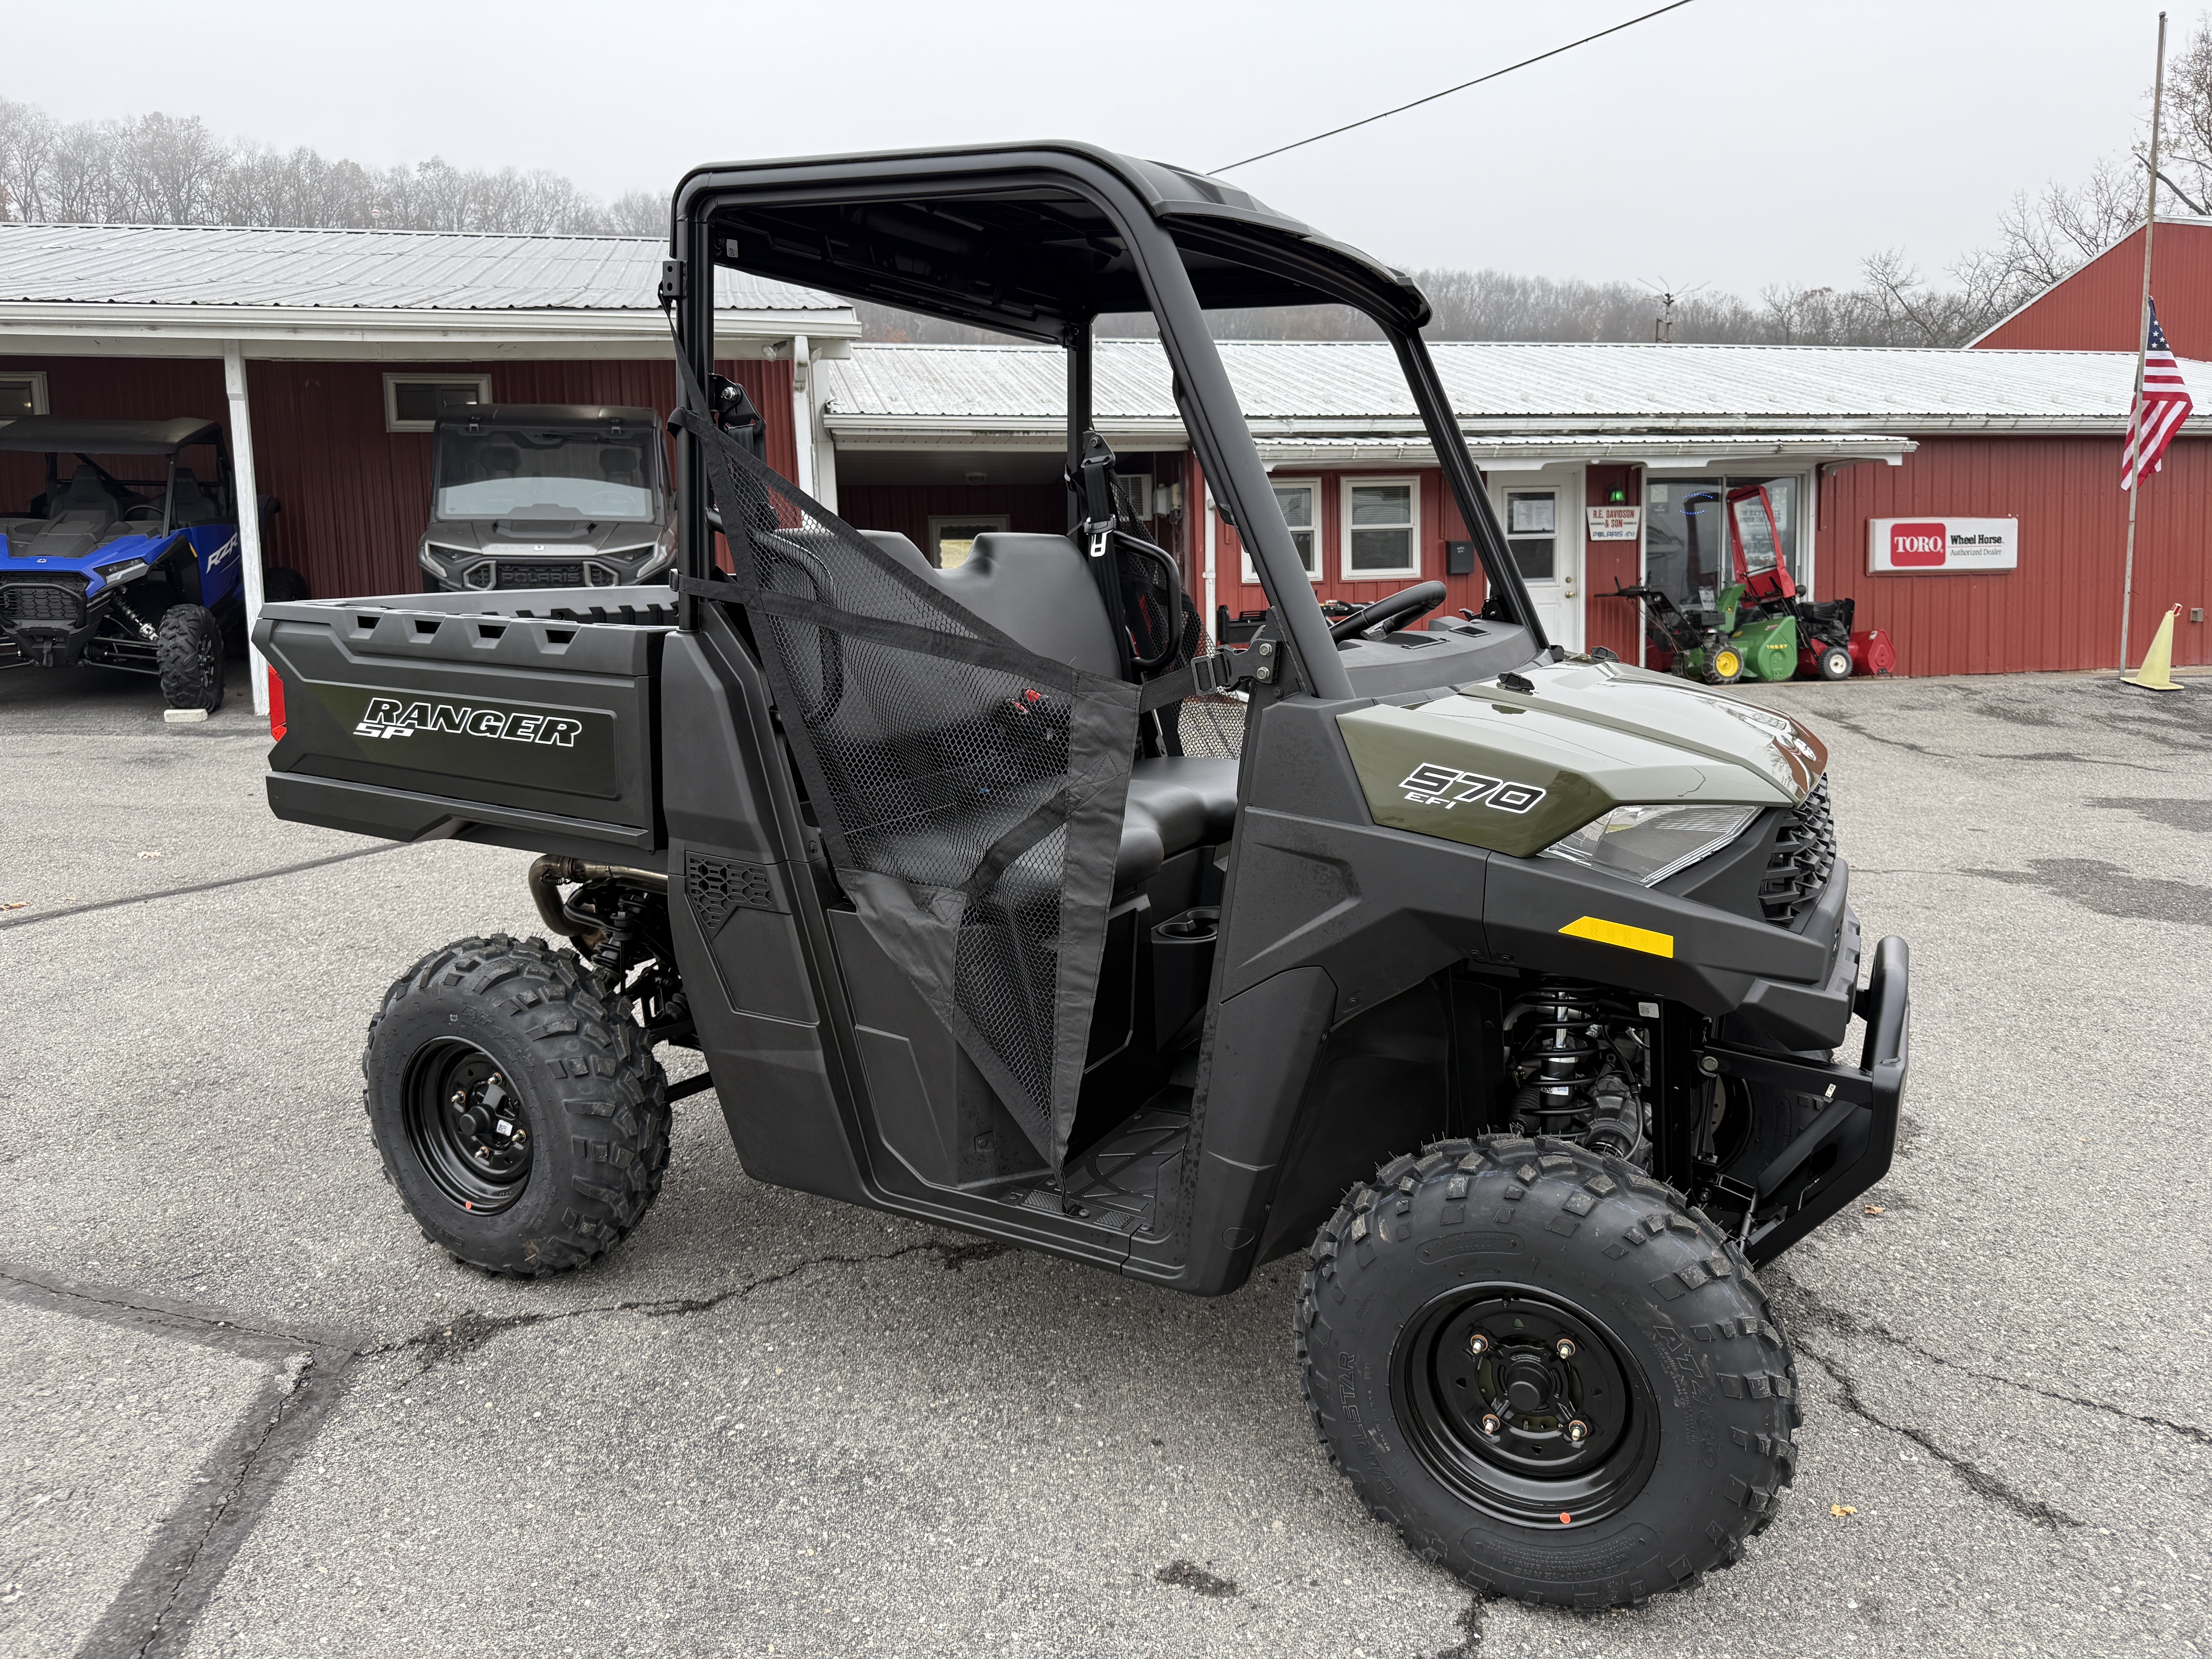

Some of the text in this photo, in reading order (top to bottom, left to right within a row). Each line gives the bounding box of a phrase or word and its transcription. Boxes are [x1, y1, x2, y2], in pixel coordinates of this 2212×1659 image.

[1593, 509, 1634, 519] R.E. DAVIDSON
[1604, 519, 1623, 528] & SON
[1894, 536, 1942, 553] TORO
[1950, 534, 1976, 545] Wheel
[206, 532, 238, 574] RZR
[501, 573, 580, 583] POLARIS
[353, 722, 414, 739] SP
[363, 697, 582, 747] RANGER
[1398, 762, 1546, 814] 570
[1404, 792, 1456, 809] EFI
[1448, 1244, 1491, 1253] TUBELESS
[1653, 1325, 1717, 1469] AT489
[1338, 1351, 1397, 1495] CARLSTAR
